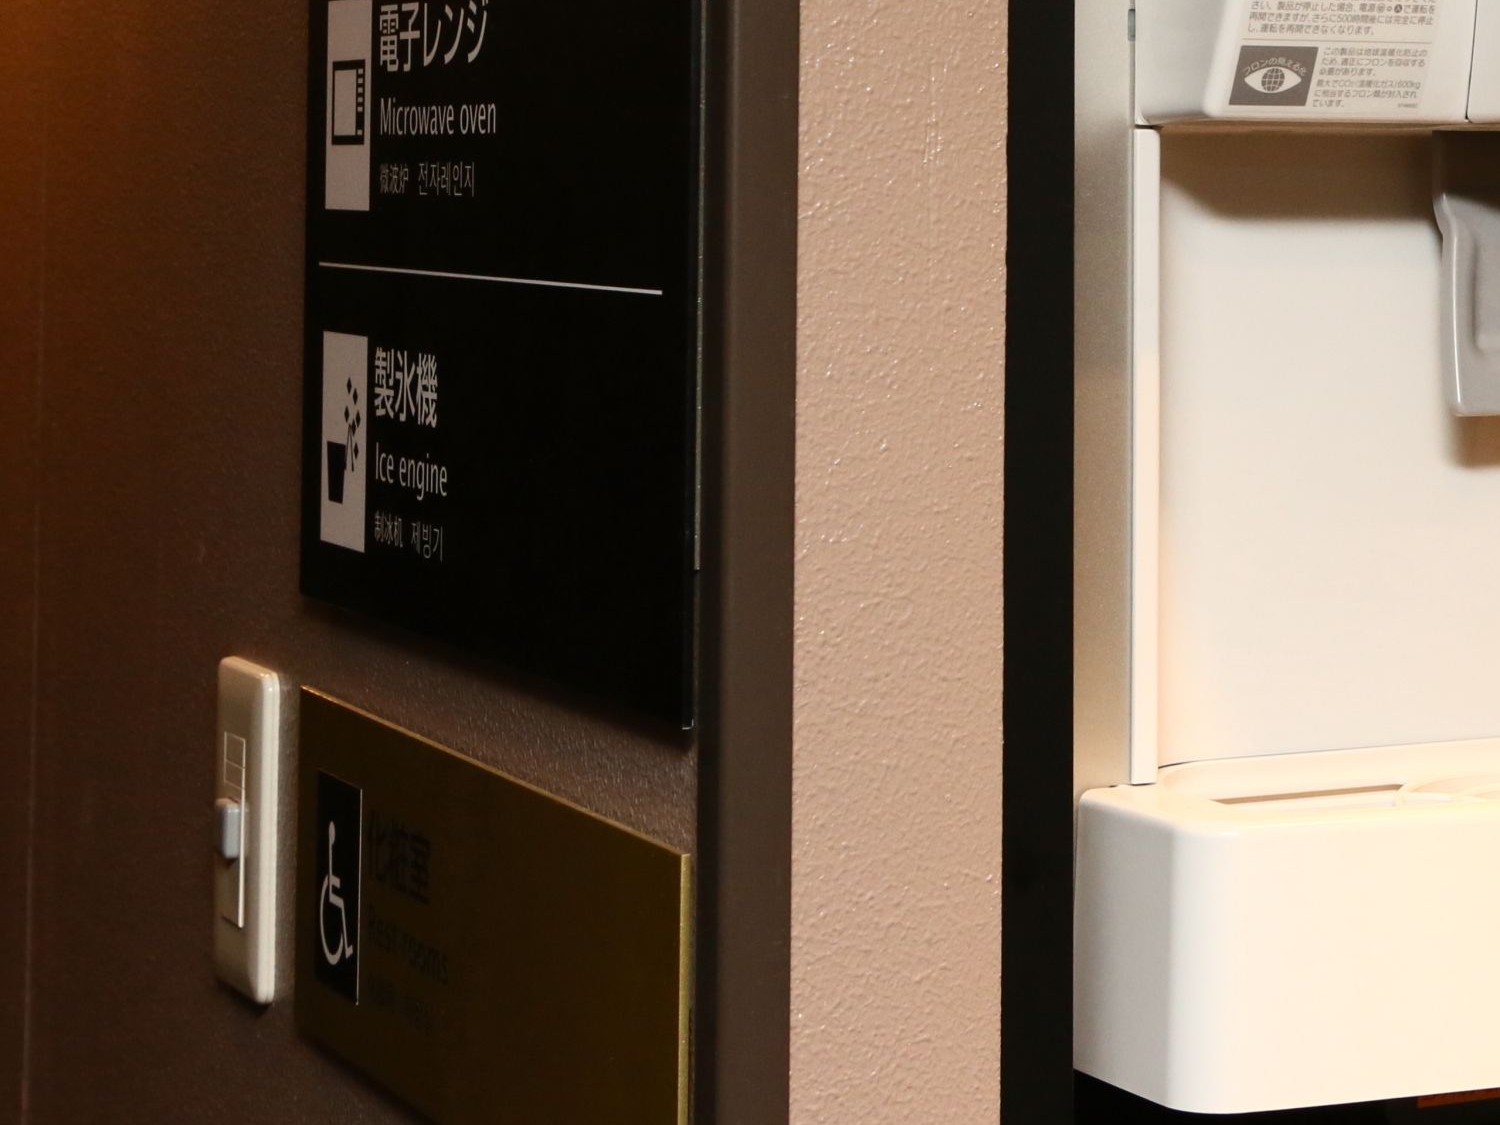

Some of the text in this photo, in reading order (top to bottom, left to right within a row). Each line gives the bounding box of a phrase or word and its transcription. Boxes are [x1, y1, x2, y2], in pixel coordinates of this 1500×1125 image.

[380, 97, 496, 137] Microwave oven
[418, 161, 475, 197] 전자레인지
[374, 346, 438, 428] 製氷機
[375, 442, 447, 501] Ice engine
[411, 520, 443, 563] 제빙기
